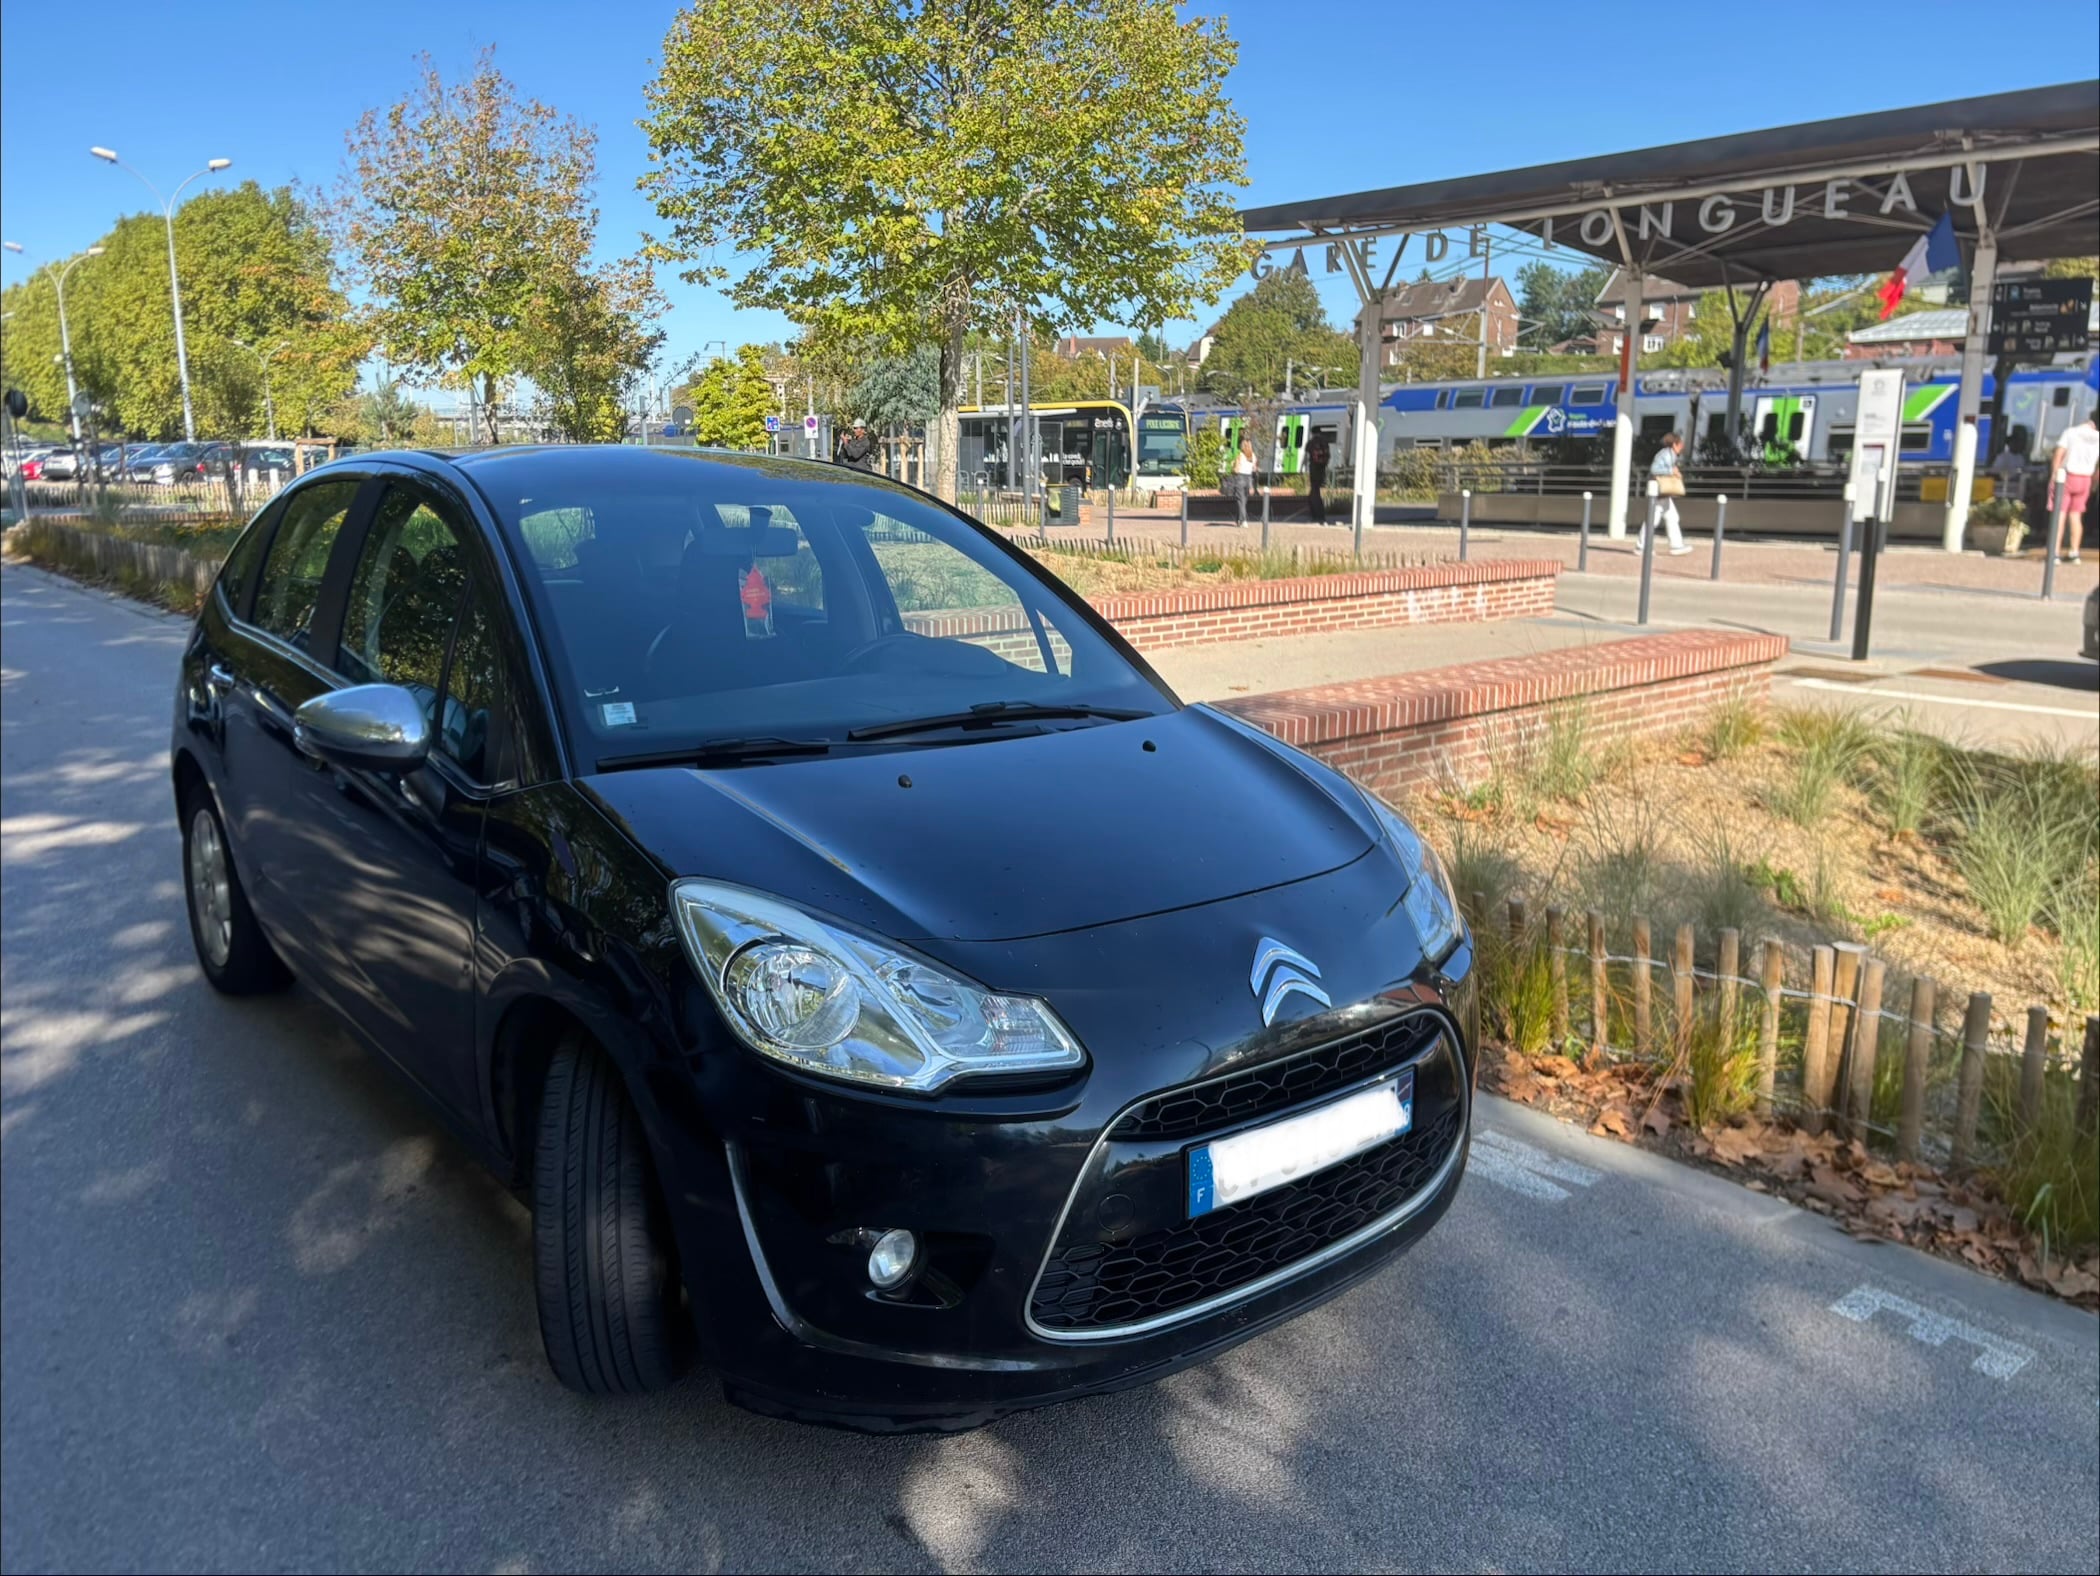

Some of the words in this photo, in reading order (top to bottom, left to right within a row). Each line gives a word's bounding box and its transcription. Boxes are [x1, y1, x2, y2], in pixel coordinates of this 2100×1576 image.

[1250, 236, 1377, 281] GARE
[1426, 223, 1488, 262] DE
[1543, 163, 1988, 251] LONGUEAU
[1196, 1187, 1206, 1204] F
